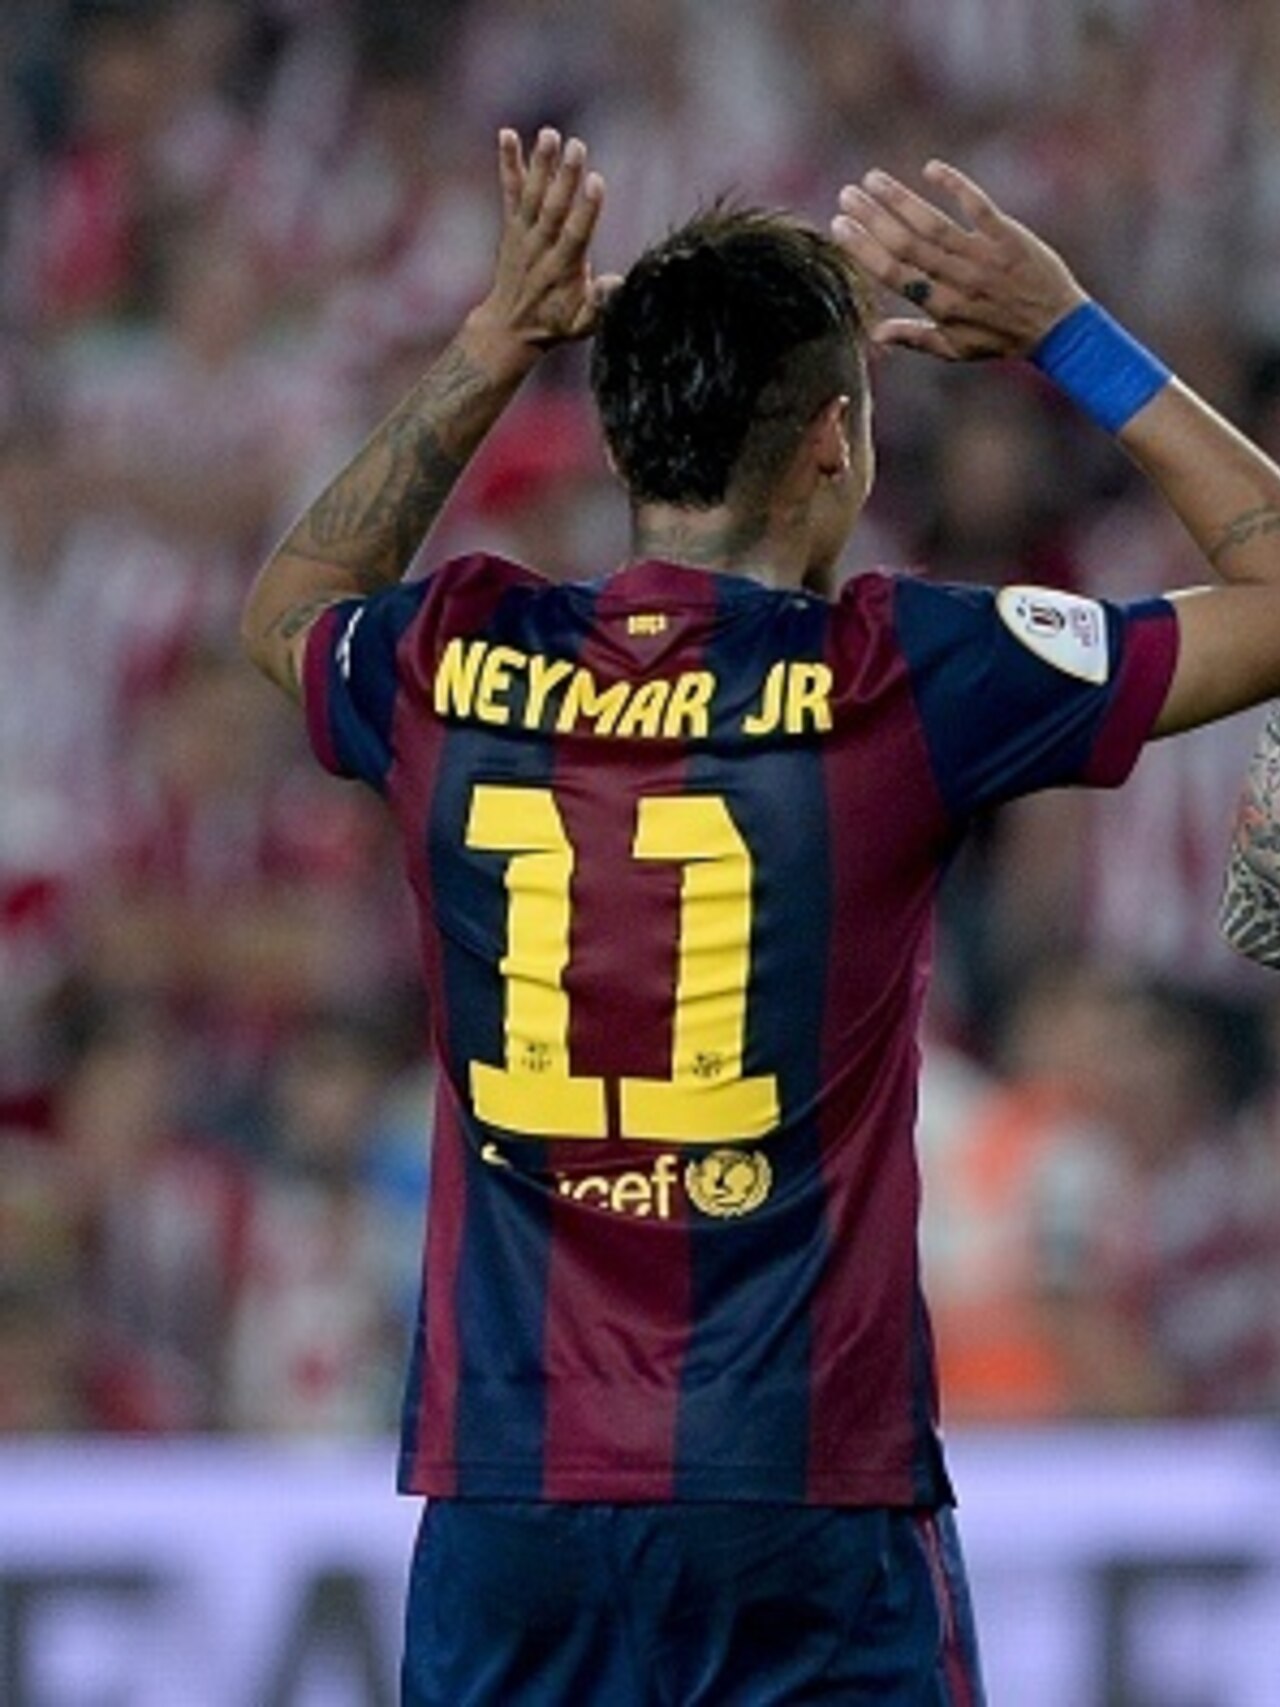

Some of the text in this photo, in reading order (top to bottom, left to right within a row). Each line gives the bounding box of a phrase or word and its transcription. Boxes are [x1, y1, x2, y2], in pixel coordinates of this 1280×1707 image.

[434, 636, 716, 738] NEYMAR
[741, 660, 833, 734] JR
[465, 784, 780, 1142] 11
